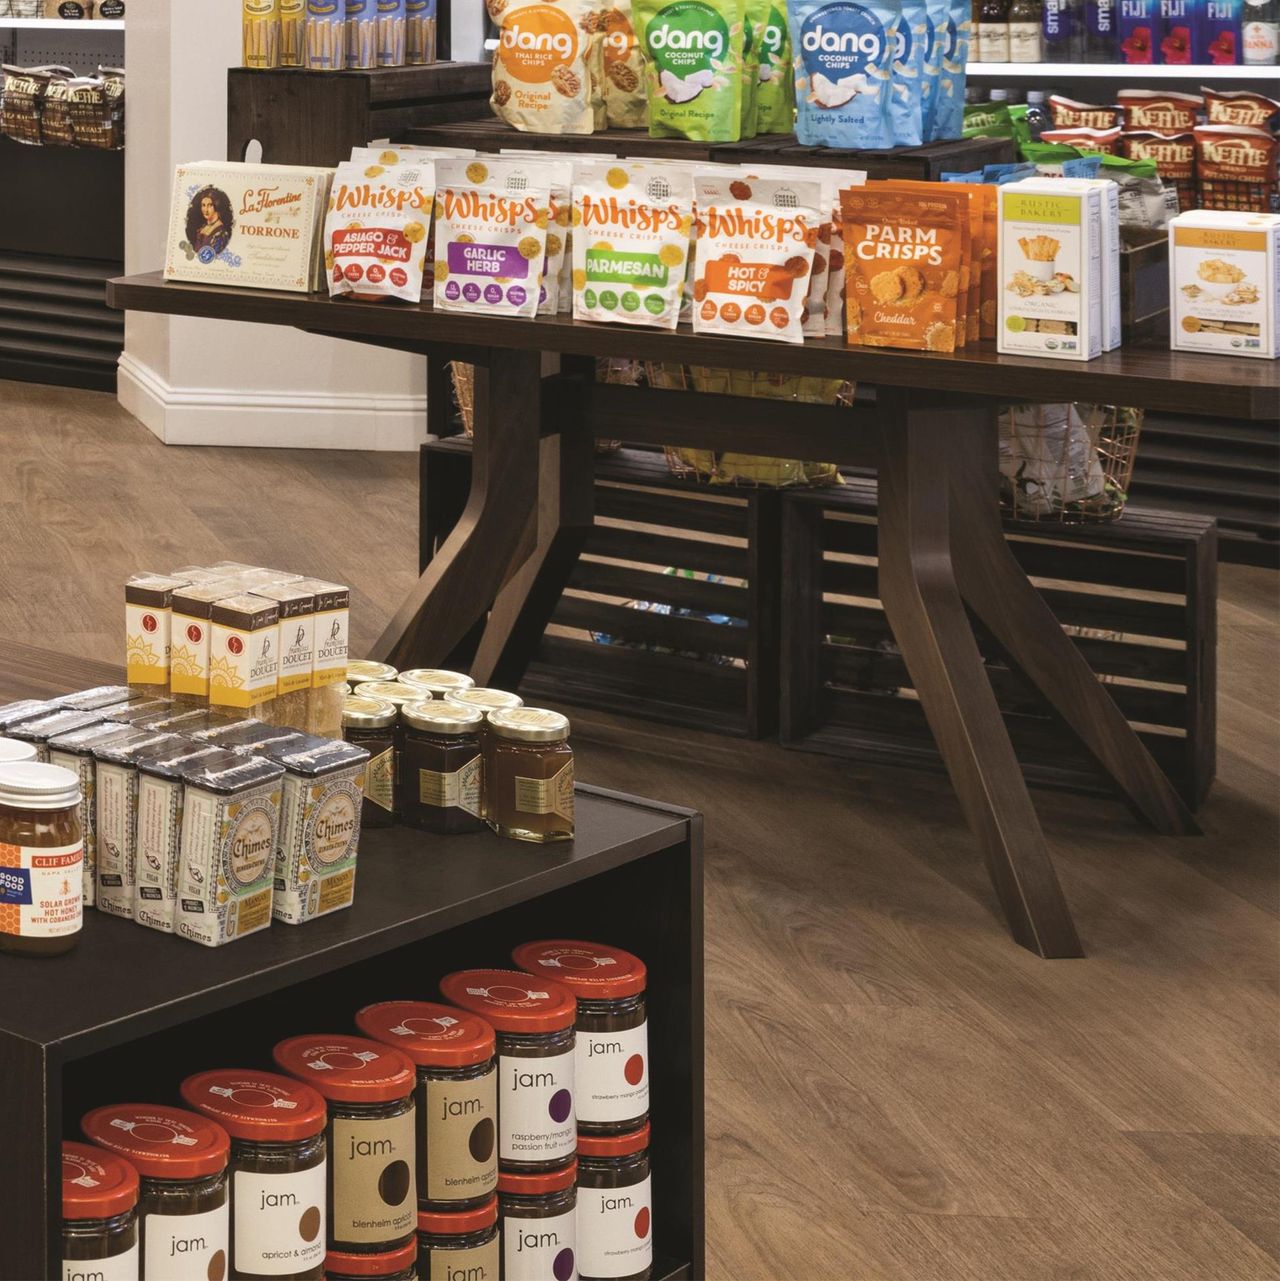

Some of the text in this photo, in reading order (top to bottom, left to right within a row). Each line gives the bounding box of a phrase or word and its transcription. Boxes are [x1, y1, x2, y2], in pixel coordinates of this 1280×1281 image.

[1122, 0, 1146, 18] FIJI
[1161, 0, 1185, 17] FIJI
[1208, 2, 1232, 18] FIJI
[503, 24, 572, 59] dang
[649, 24, 724, 57] dang
[803, 25, 880, 61] dang
[819, 55, 859, 63] COCONUT
[515, 90, 551, 103] Original
[518, 101, 548, 111] Recipe
[660, 109, 715, 119] Original Recipe
[811, 114, 864, 125] Lightly Salted
[1203, 141, 1269, 166] KETTLE
[239, 187, 301, 215] La Florentine
[337, 185, 425, 211] Whisps
[1021, 199, 1062, 208] RUSTIC
[445, 189, 539, 226] Whisps
[582, 195, 682, 233] Whisps
[1021, 209, 1062, 217] BAKERY
[240, 225, 300, 239] TORRONE
[709, 207, 809, 243] Whisps
[343, 231, 383, 243] ASIAGO
[866, 225, 937, 244] PARM
[334, 243, 408, 259] PEPPER JACK
[464, 247, 506, 261] GARLIC
[857, 241, 942, 265] CRISPS
[467, 260, 500, 273] HERB
[587, 259, 664, 278] PARMESAN
[728, 267, 755, 279] HOT
[728, 280, 765, 292] SPICY
[874, 311, 916, 325] Cheddar
[283, 651, 312, 664] DOUCET
[318, 646, 348, 658] DOUCET
[250, 662, 278, 678] DOUCET
[315, 820, 354, 841] Chimes
[233, 837, 272, 858] Chimes
[35, 858, 58, 866] CLIF
[0, 873, 24, 884] GOOD
[0, 879, 24, 891] FOOD
[180, 922, 212, 943] Chimes
[589, 1039, 621, 1057] jam
[512, 1069, 554, 1090] jam
[350, 1136, 392, 1160] jam
[512, 1141, 558, 1151] passion fruit
[260, 1191, 297, 1210] jam
[601, 1196, 632, 1213] jam
[353, 1212, 412, 1229] blenheim apricot
[171, 1236, 206, 1256] jam
[517, 1230, 558, 1251] jam
[262, 1250, 291, 1261] apricot
